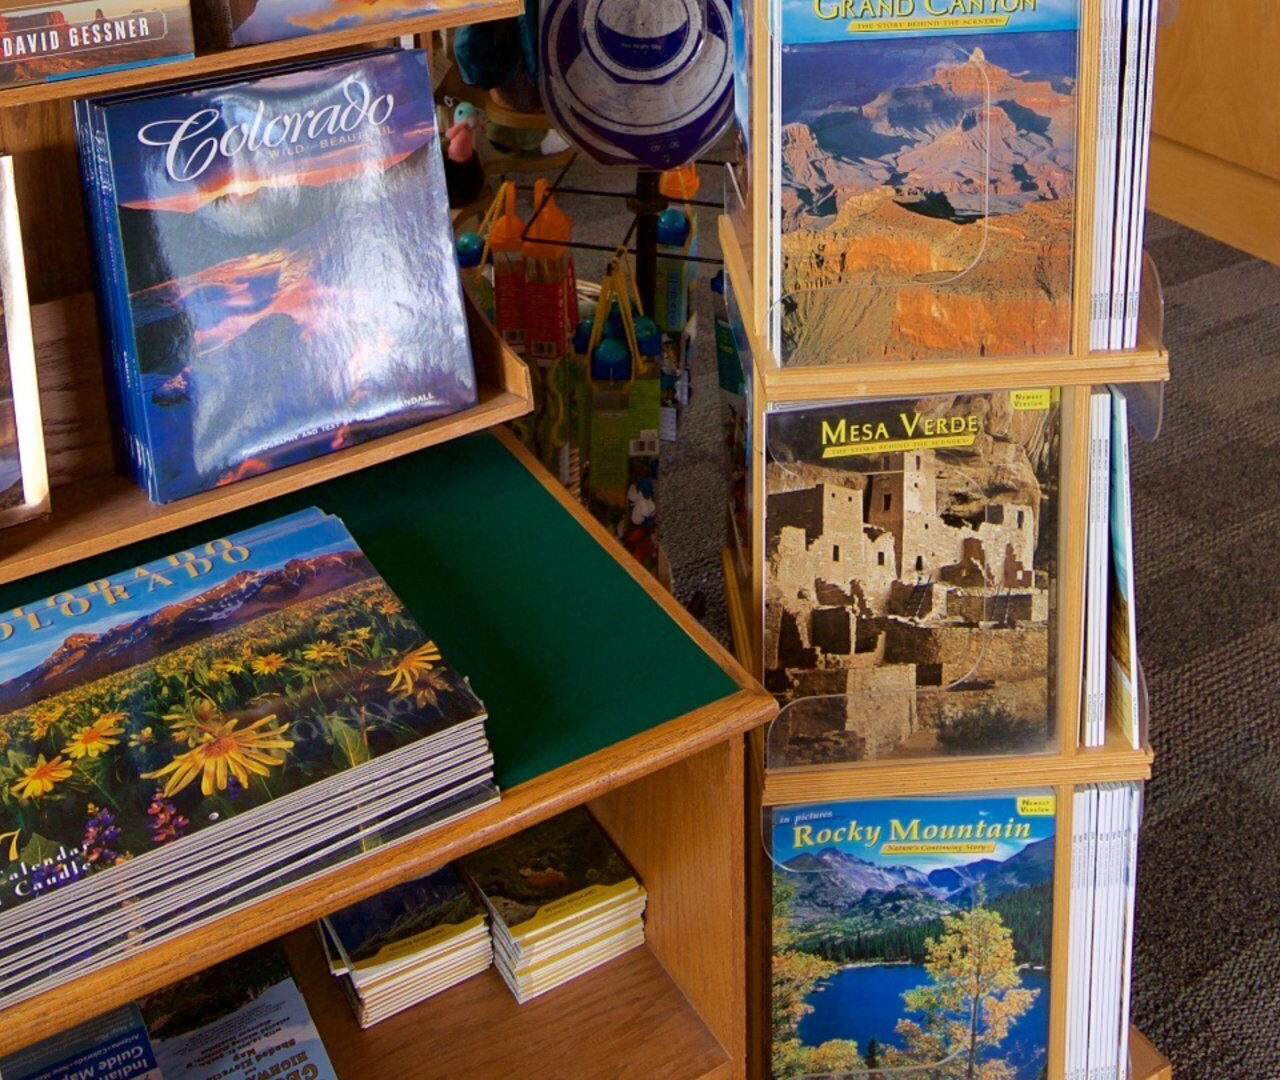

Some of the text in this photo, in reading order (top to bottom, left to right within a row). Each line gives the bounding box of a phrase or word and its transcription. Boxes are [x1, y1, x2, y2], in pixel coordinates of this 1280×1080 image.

[2, 17, 151, 59] DAVID GESSNER
[137, 73, 395, 183] Colorado
[821, 413, 979, 446] MESA VERDE
[779, 810, 833, 825] in pictures
[792, 817, 1032, 850] Rocky Mountain
[14, 860, 93, 898] Caudle
[97, 1044, 144, 1069] Guide
